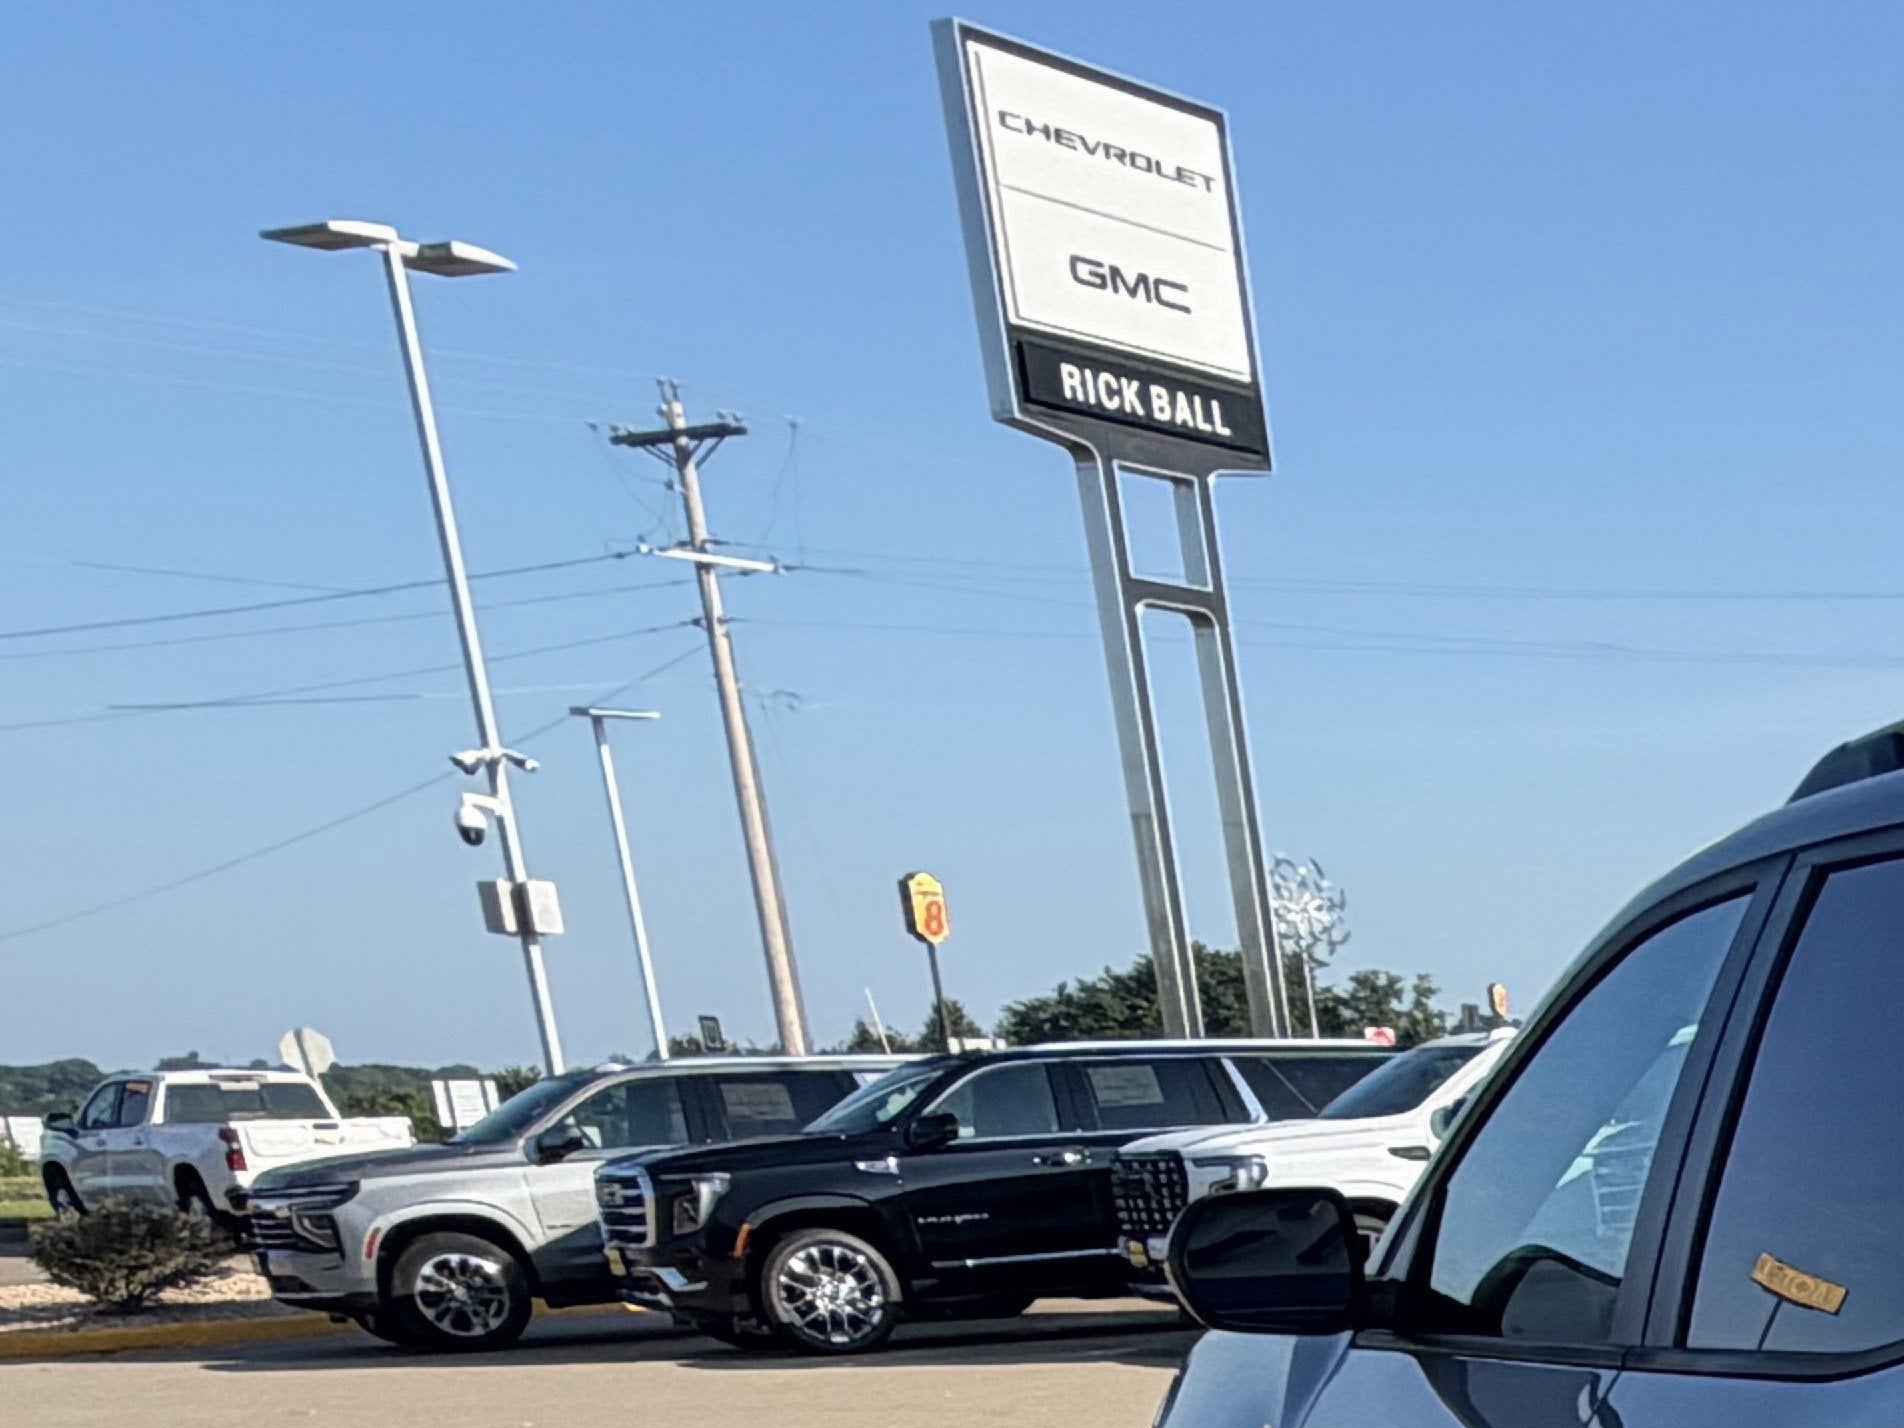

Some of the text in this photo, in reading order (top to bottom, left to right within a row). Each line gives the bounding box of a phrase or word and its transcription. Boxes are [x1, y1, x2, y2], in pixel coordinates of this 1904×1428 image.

[999, 110, 1216, 194] CHEVROLET
[1069, 254, 1192, 314] GMC
[1060, 362, 1232, 436] RICK BALL
[924, 900, 945, 936] 8
